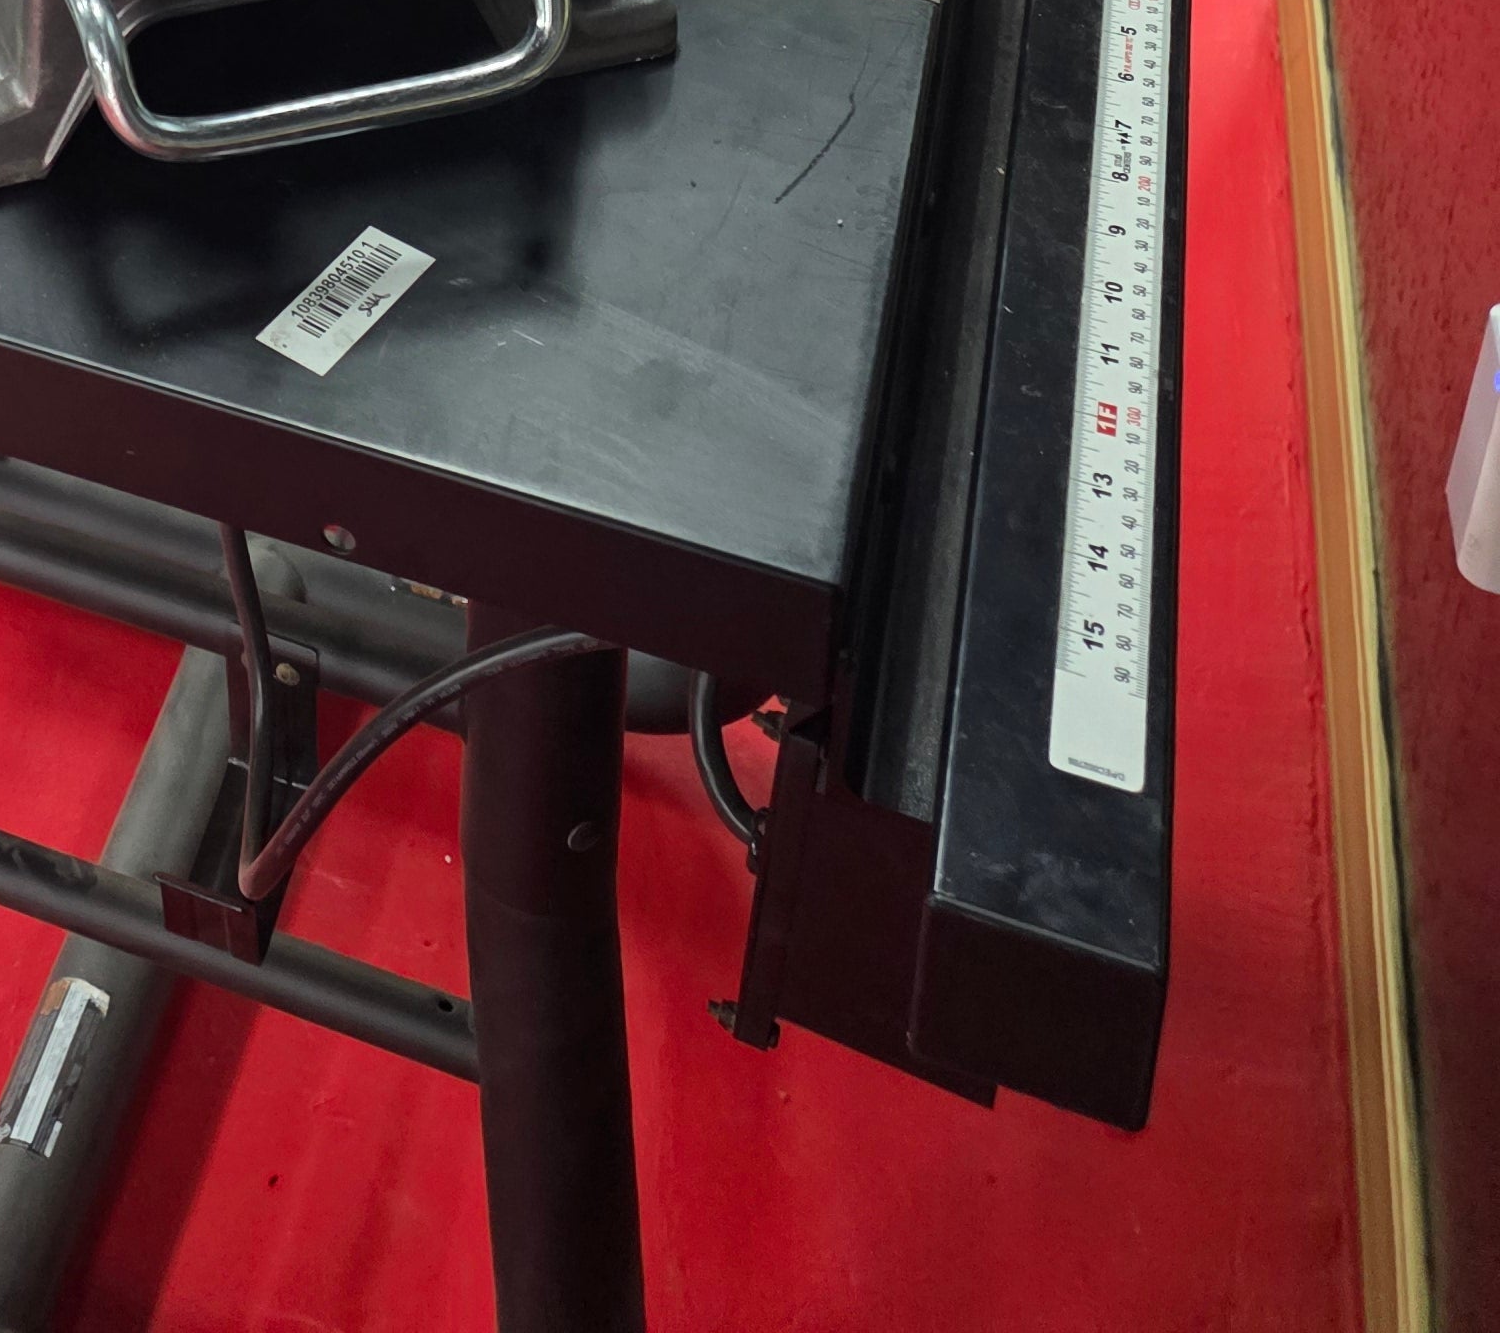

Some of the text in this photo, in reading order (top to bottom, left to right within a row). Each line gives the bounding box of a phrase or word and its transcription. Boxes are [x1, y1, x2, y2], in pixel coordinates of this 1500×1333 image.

[1146, 6, 1159, 14] 10
[1120, 25, 1137, 36] 5
[1145, 24, 1158, 33] 20
[1144, 41, 1157, 51] 30
[1144, 59, 1156, 69] 40
[1118, 72, 1134, 82] 6
[1143, 78, 1156, 88] 50
[1142, 96, 1155, 107] 60
[1115, 119, 1132, 130] 7
[1141, 115, 1154, 126] 70
[1140, 135, 1153, 146] 80
[1139, 155, 1152, 166] 90
[1138, 176, 1151, 192] 200
[1137, 196, 1150, 206] 10
[1136, 218, 1150, 230] 20
[1135, 240, 1149, 251] 30
[1134, 262, 1148, 274] 40
[1133, 284, 1147, 297] 50
[1131, 308, 1146, 321] 60
[1130, 332, 1144, 345] 70
[1129, 356, 1143, 370] 80
[1128, 381, 1143, 394] 90
[1082, 171, 1129, 651] 15 14 13 1F 11 10 9 8
[1126, 406, 1142, 426] 300
[1125, 432, 1140, 445] 10
[1124, 459, 1139, 474] 20
[1122, 487, 1138, 502] 30
[1121, 515, 1137, 530] 40
[1120, 544, 1135, 560] 50
[1118, 573, 1135, 590] 60
[1117, 603, 1134, 620] 70
[1116, 635, 1132, 652] 80
[1114, 666, 1130, 684] 90
